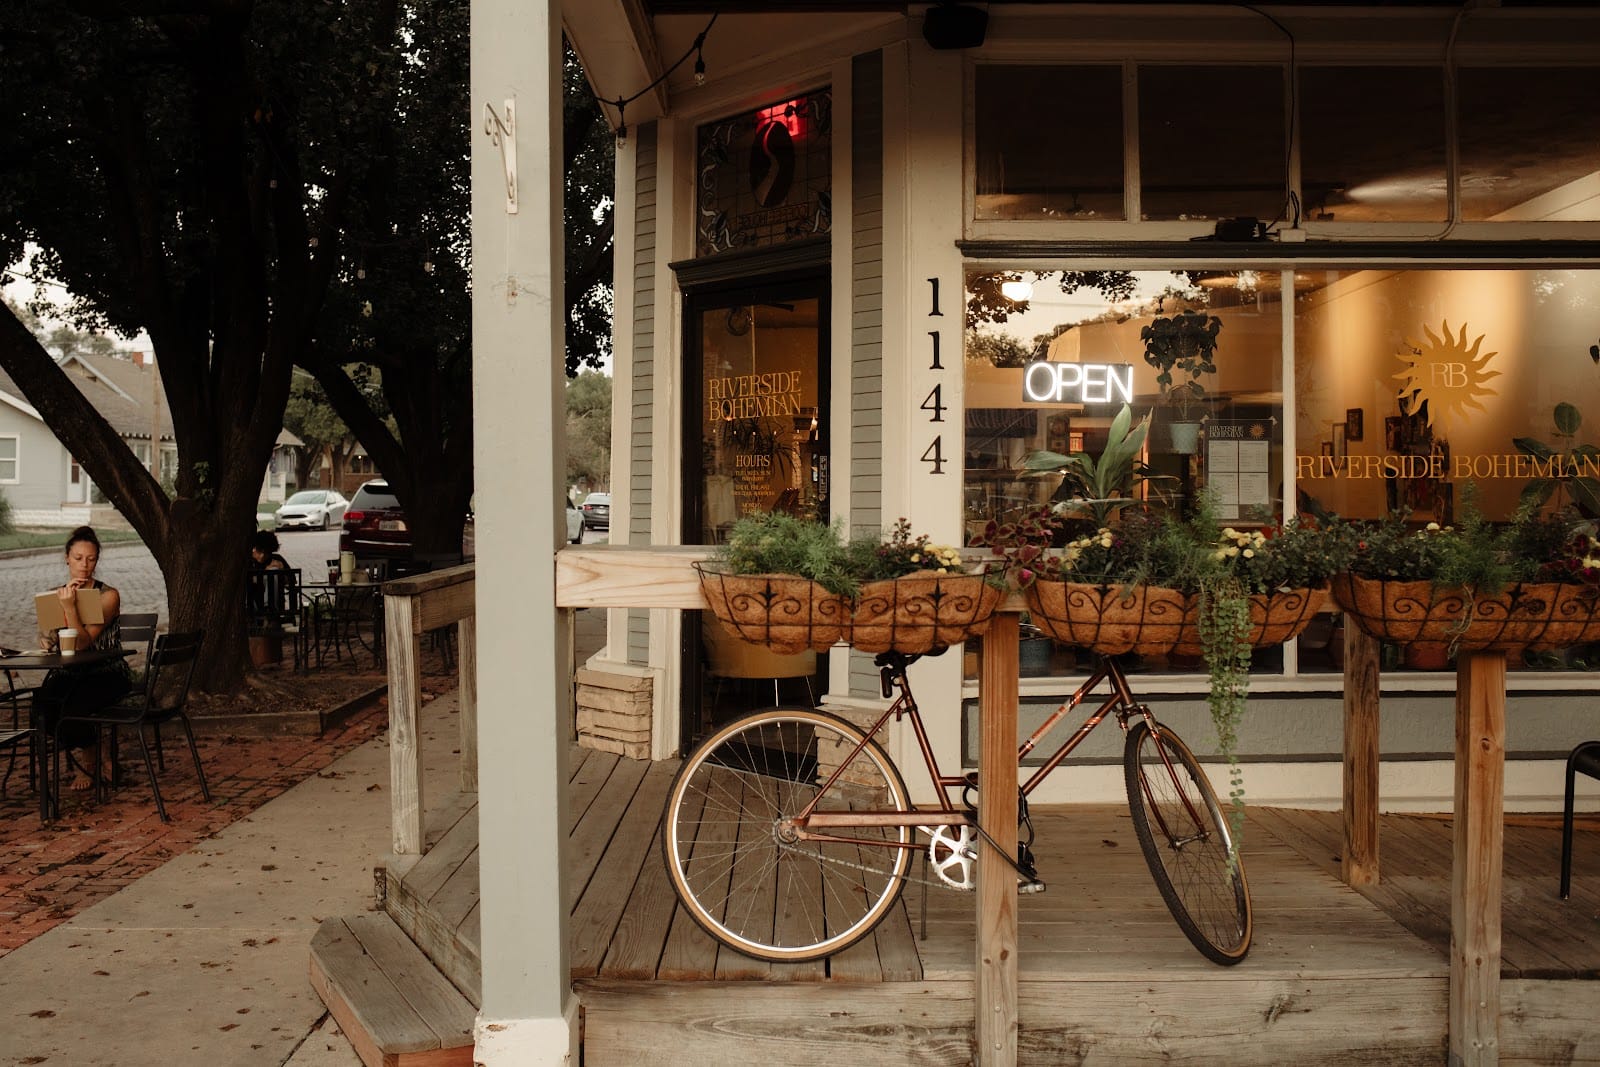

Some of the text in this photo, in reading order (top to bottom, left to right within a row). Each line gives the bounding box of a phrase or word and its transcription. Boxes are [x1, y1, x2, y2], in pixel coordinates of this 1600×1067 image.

[709, 370, 801, 400] RIVERSIDE
[920, 277, 947, 475] 1144
[1025, 362, 1134, 404] OPEN
[1430, 362, 1468, 388] RB
[709, 393, 801, 421] BOHEMIAN
[736, 454, 770, 468] HOURS
[1296, 454, 1600, 479] RIVERSIDE BOHEMIAN
